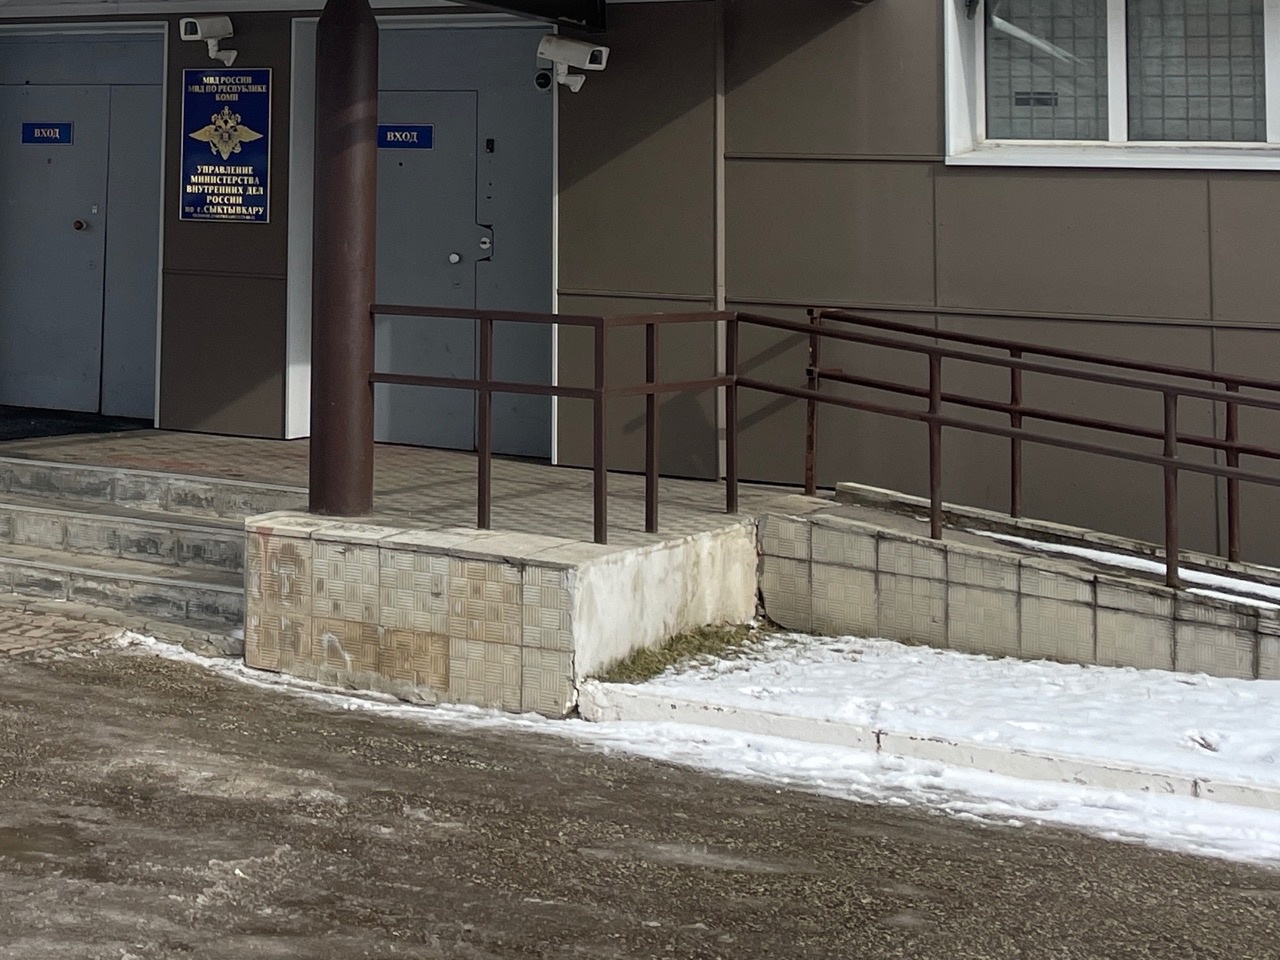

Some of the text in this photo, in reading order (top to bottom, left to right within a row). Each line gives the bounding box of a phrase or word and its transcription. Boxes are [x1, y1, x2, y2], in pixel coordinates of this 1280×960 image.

[202, 76, 252, 84] МВД РОССИИ
[188, 85, 205, 93] МВД
[218, 85, 267, 93] РЕСПУБЛИКЕ
[215, 93, 239, 101] КОМИ
[34, 128, 60, 139] ВХОД
[386, 131, 418, 143] ВХОД
[197, 165, 254, 174] УПРАВЛЕНИЕ
[190, 175, 260, 185] МИНИСТЕРСТВА
[186, 185, 264, 195] ВНУТРЕННИХ ДЕЛ
[206, 195, 243, 204] РОССИИ
